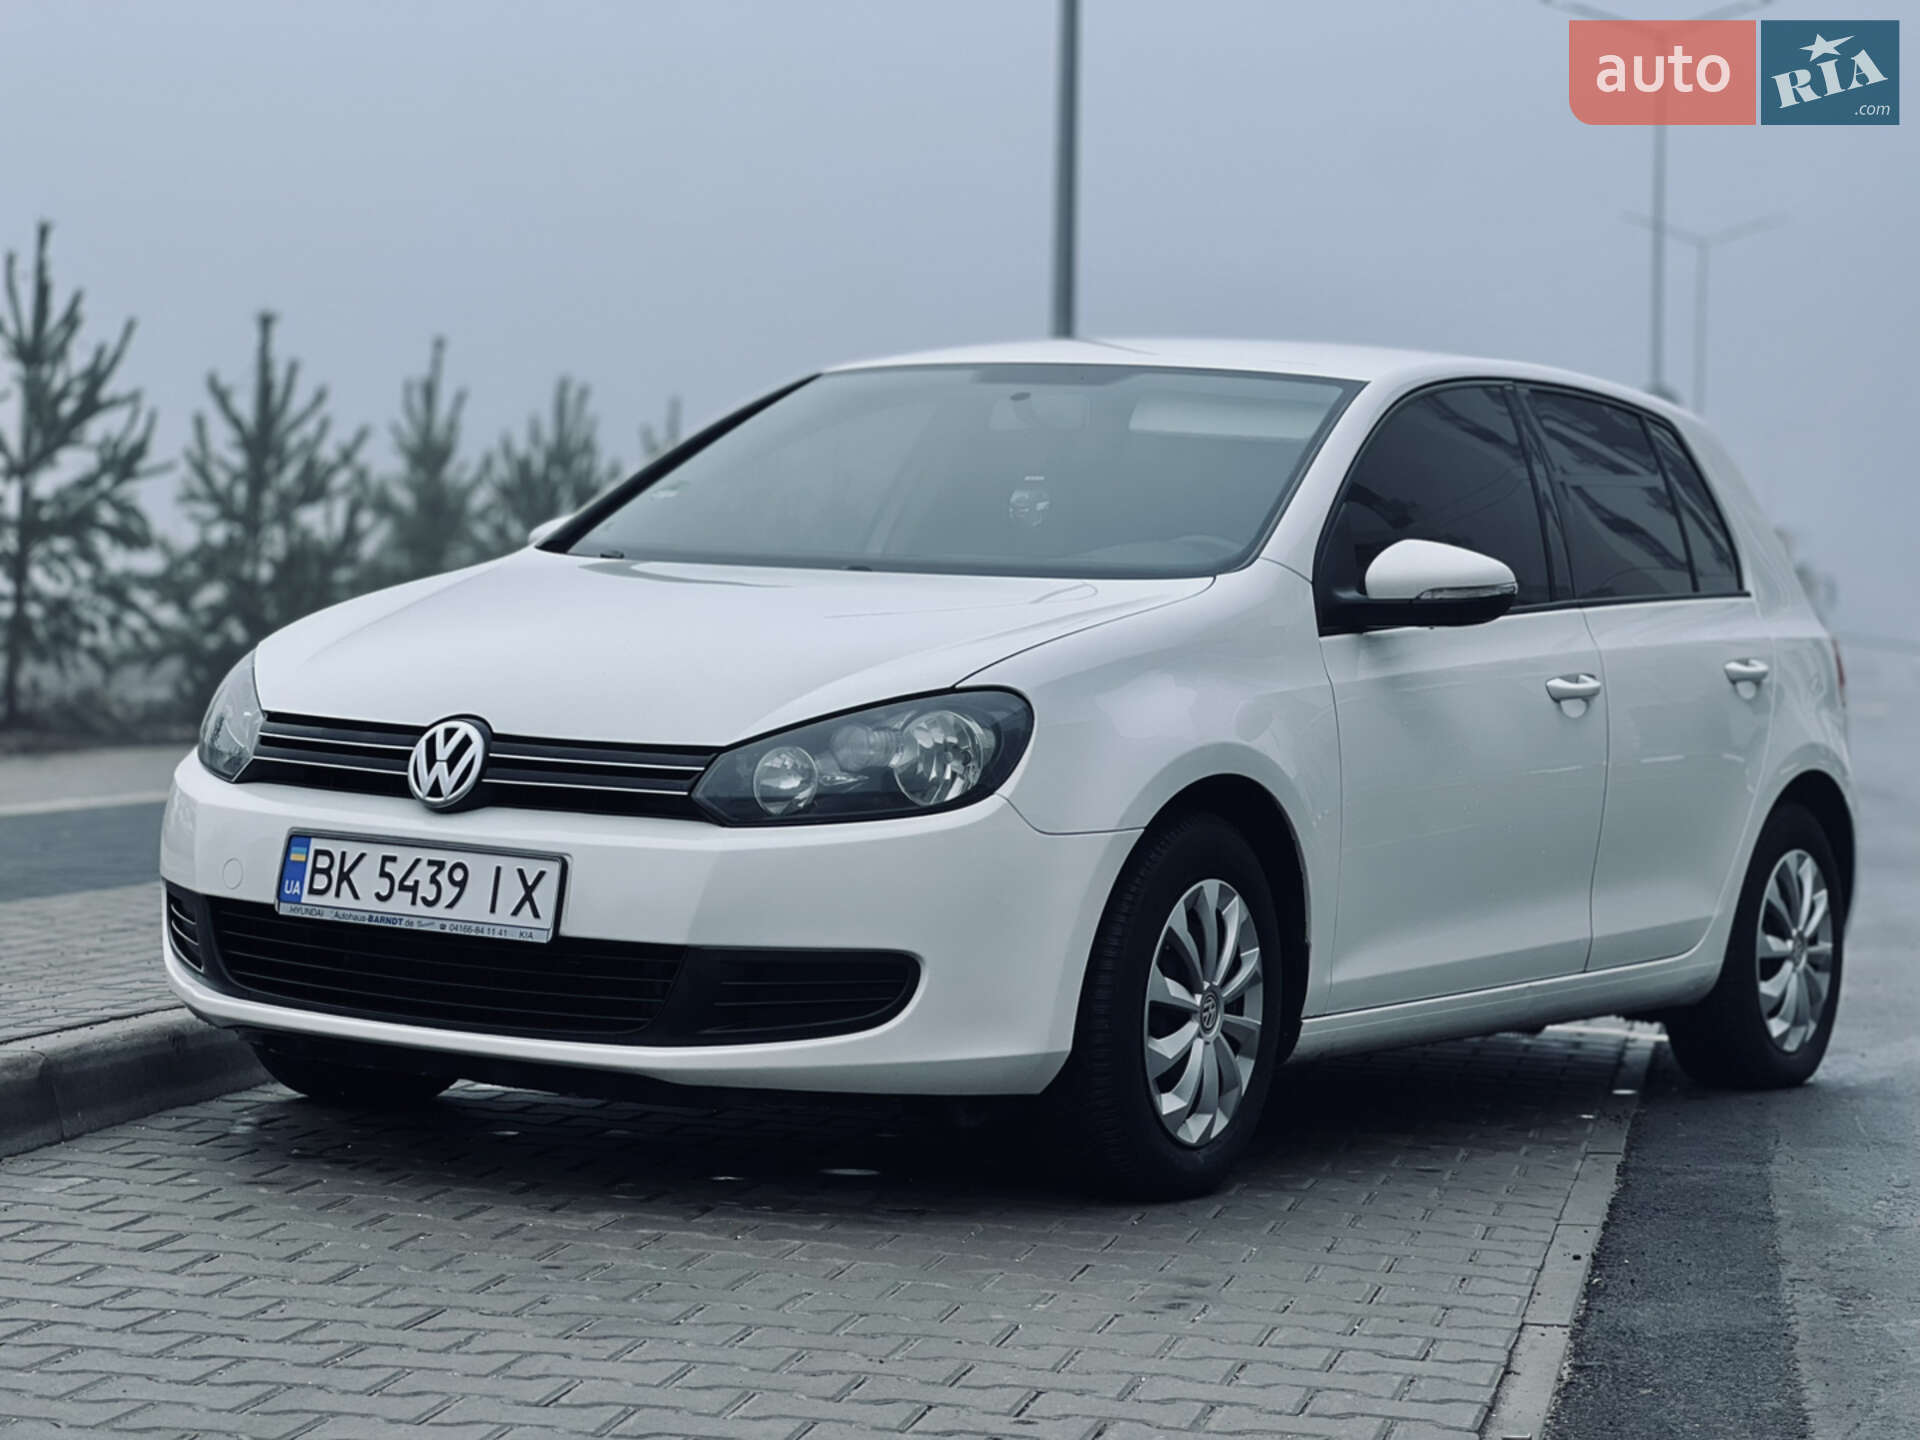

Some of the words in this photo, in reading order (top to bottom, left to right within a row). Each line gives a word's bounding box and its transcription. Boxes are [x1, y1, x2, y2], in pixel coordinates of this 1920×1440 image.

[284, 879, 301, 896] UA
[307, 848, 367, 900] BK
[374, 855, 469, 909] 5439
[489, 865, 547, 919] IX
[289, 905, 324, 917] HYUNDAI
[519, 929, 534, 939] KIA
